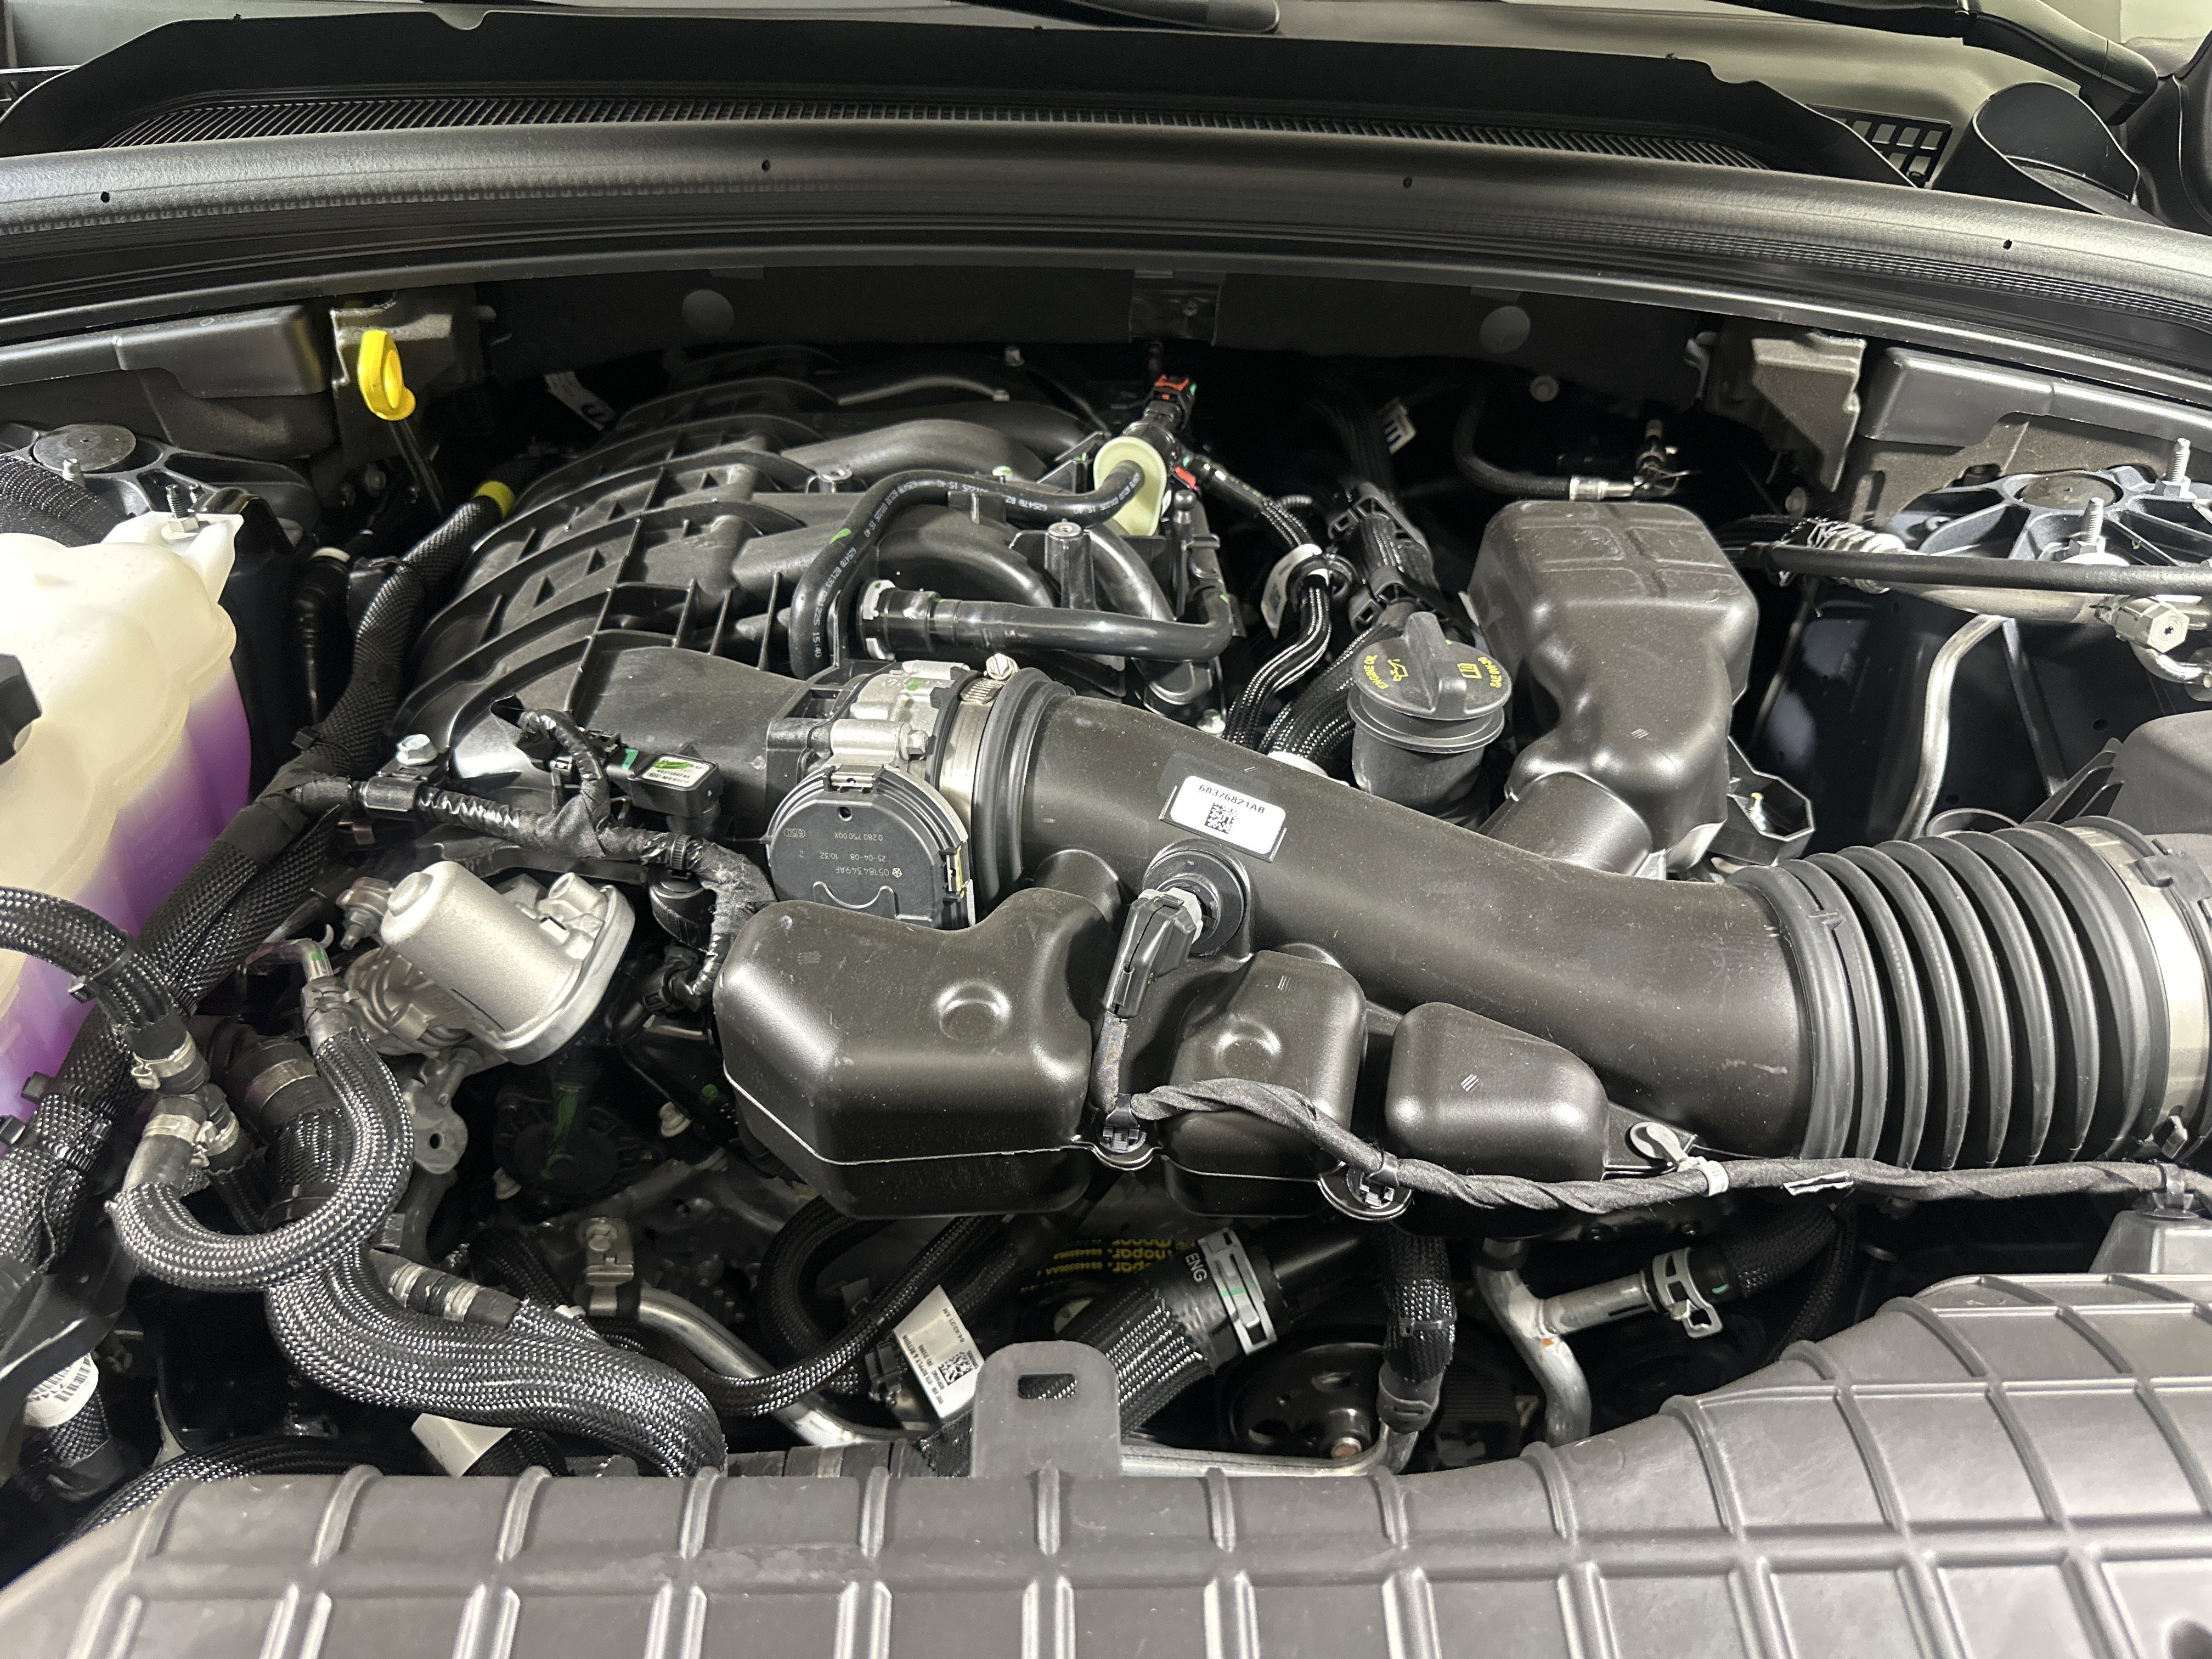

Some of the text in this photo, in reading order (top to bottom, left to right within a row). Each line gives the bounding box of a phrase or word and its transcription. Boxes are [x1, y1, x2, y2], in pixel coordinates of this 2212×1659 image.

[812, 632, 822, 658] 15:40
[1364, 654, 1389, 690] ENGINE OIL
[1478, 657, 1502, 688] SAE 0W-20
[662, 776, 690, 784] MEXICO
[1199, 785, 1265, 814] 68376821AB
[851, 853, 887, 862] 25-04-08
[835, 866, 889, 877] 05184349AF
[1185, 1252, 1206, 1283] ENG
[943, 1307, 951, 1318] AM
[902, 1334, 916, 1354] RETURN
